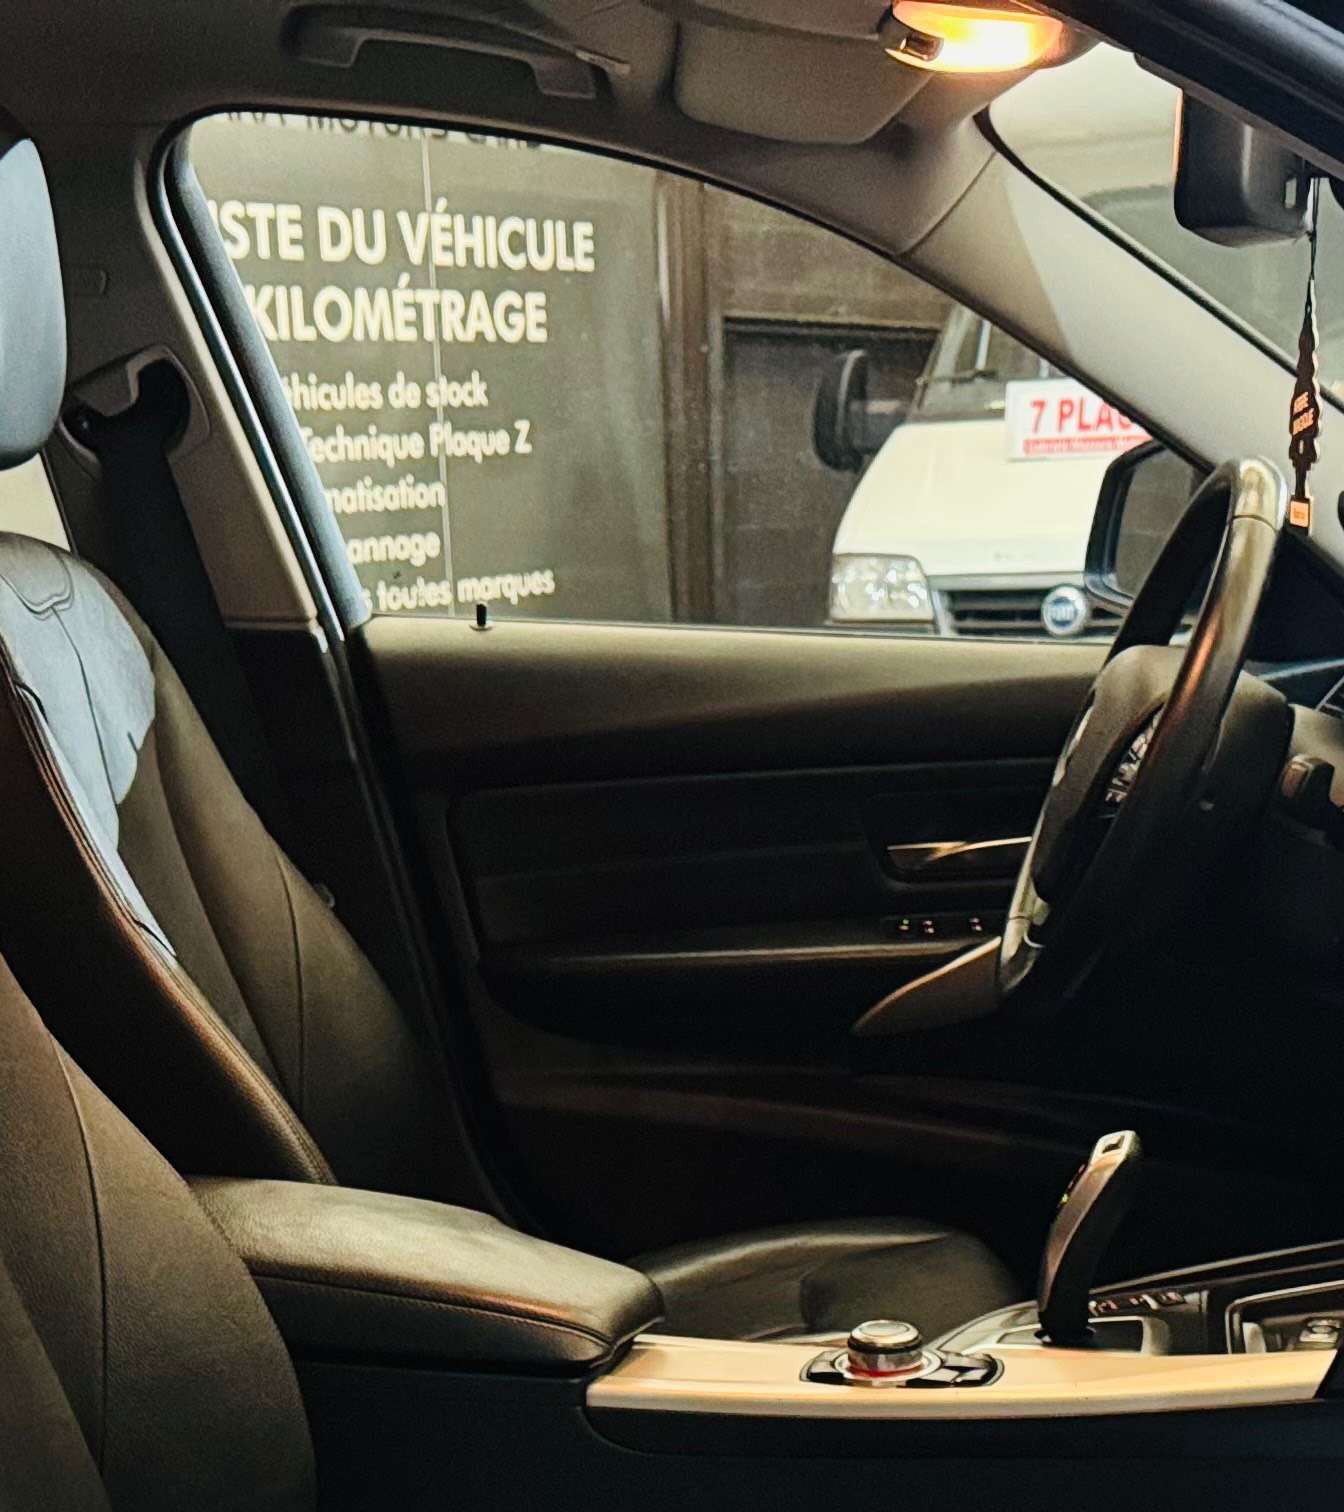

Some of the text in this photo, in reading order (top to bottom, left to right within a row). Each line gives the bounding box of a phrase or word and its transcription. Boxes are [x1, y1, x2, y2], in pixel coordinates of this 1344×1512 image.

[317, 205, 386, 265] DU
[396, 196, 596, 272] VÉHICULE
[244, 271, 548, 343] KILOMÉTRAGE
[388, 370, 422, 409] de
[425, 370, 489, 408] stock
[1031, 399, 1047, 434] 7
[429, 421, 511, 464] Plaque
[514, 419, 533, 454] Z
[376, 576, 454, 611] toutes
[457, 569, 556, 605] marques
